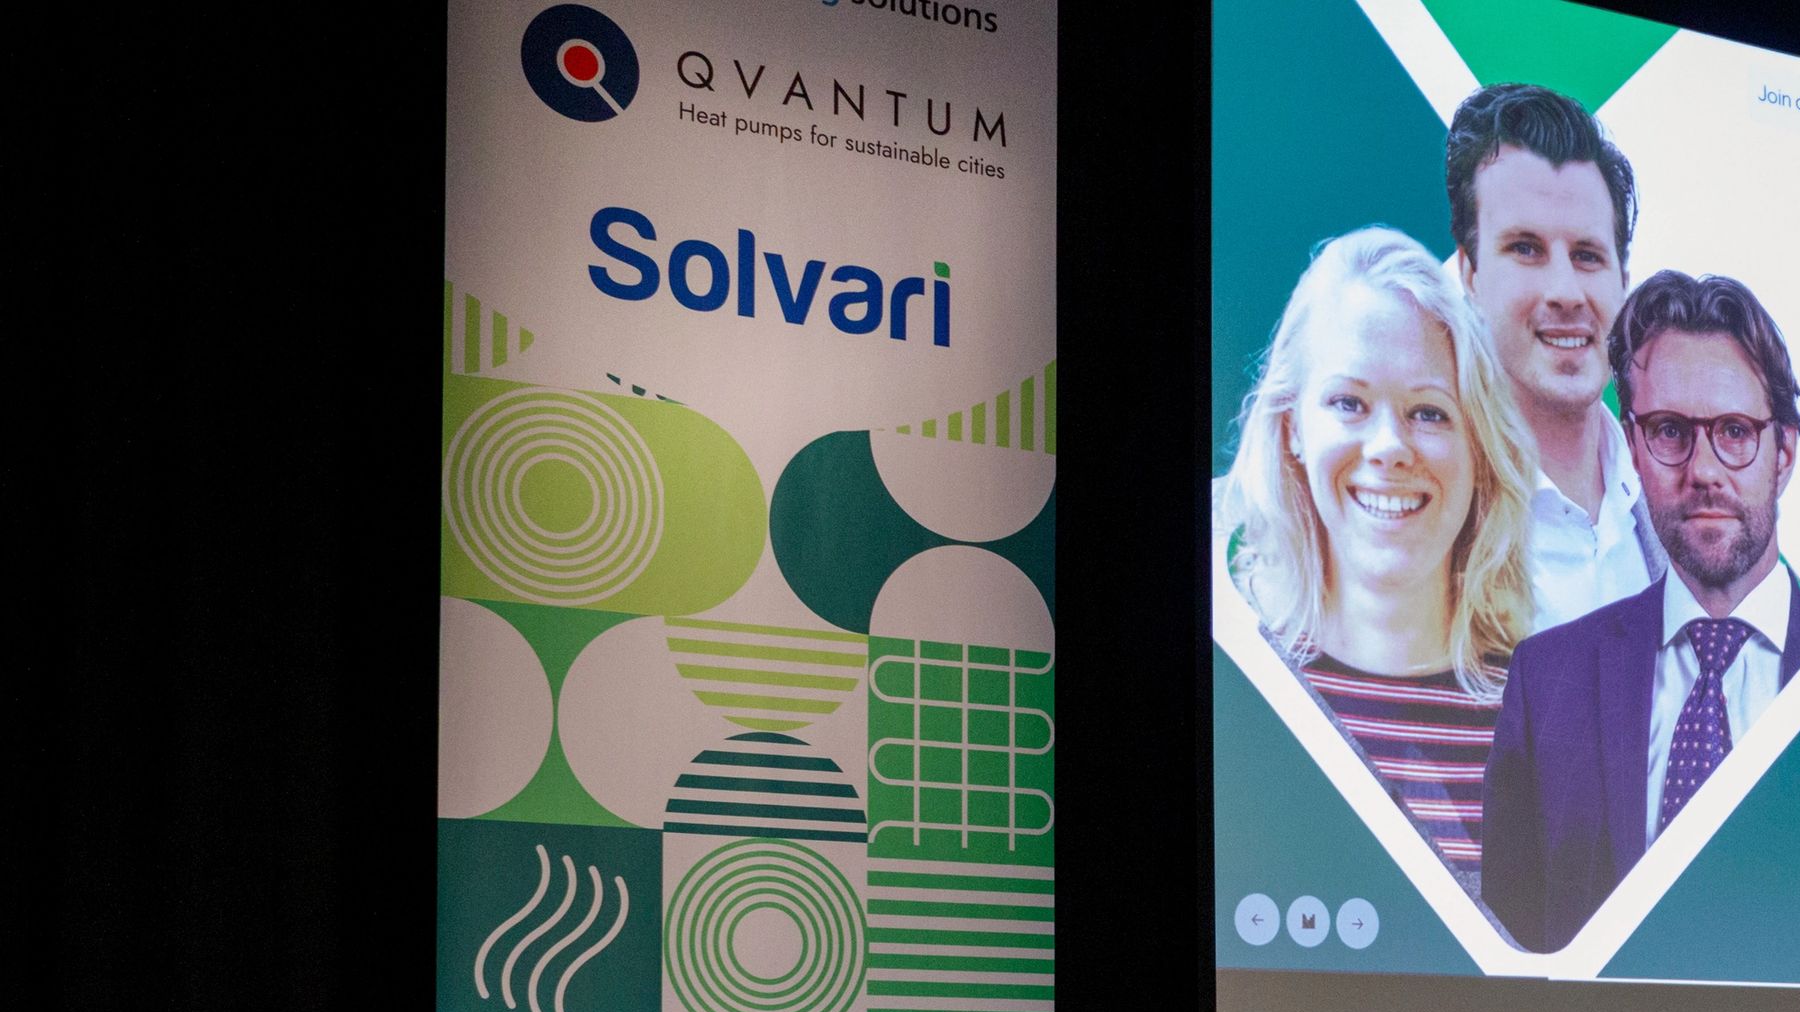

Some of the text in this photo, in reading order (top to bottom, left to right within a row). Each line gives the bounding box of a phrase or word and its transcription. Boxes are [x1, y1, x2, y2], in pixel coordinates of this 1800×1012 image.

[852, 0, 998, 33] utions
[676, 50, 1008, 148] QVANTUM
[1758, 85, 1792, 106] Join
[678, 101, 1006, 180] Heat pumps for sustainable cities
[587, 206, 951, 348] Solvari
